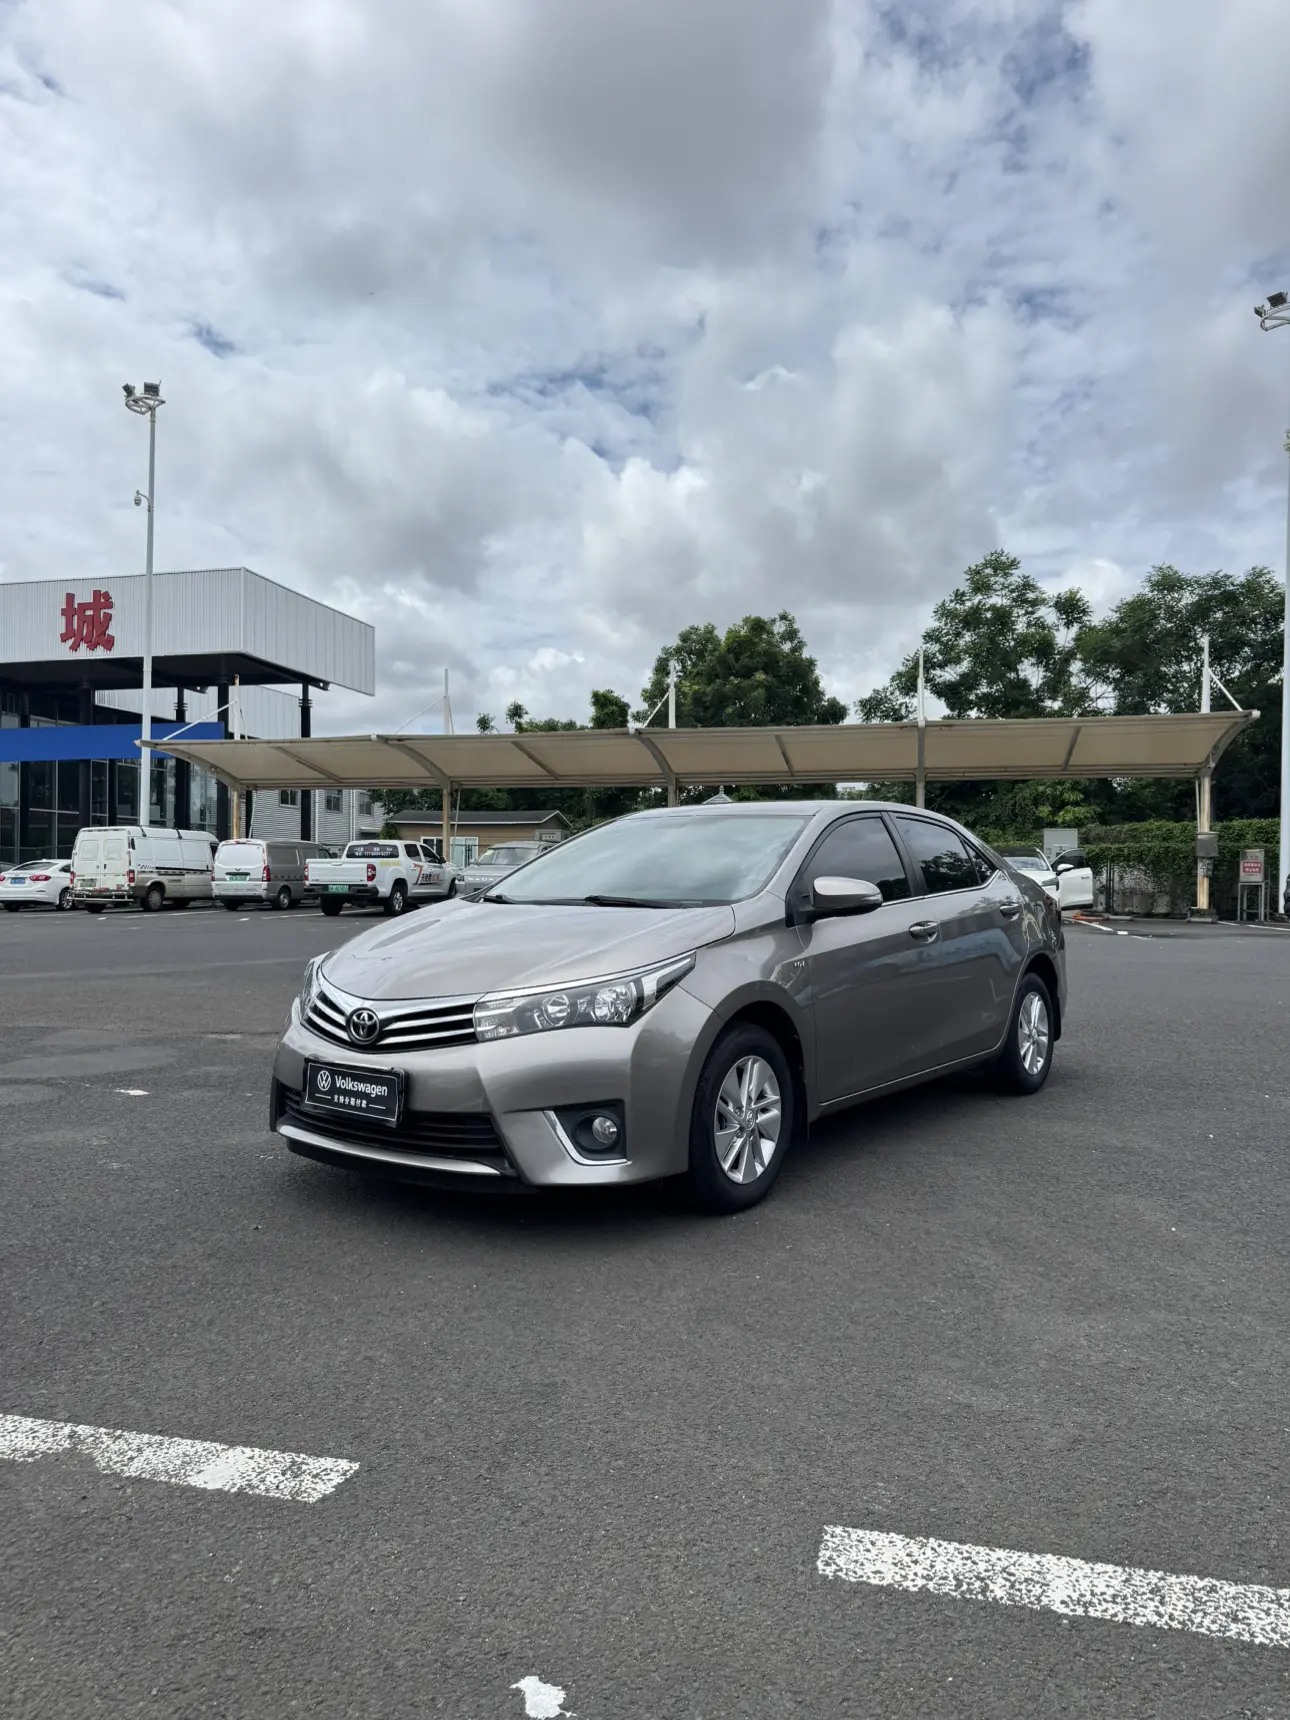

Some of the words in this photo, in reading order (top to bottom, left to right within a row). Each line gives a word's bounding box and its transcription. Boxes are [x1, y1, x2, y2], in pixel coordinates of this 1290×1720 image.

[60, 589, 115, 653] 城
[335, 1074, 388, 1097] Volkswagen
[333, 1094, 367, 1108] 支持分期付款
